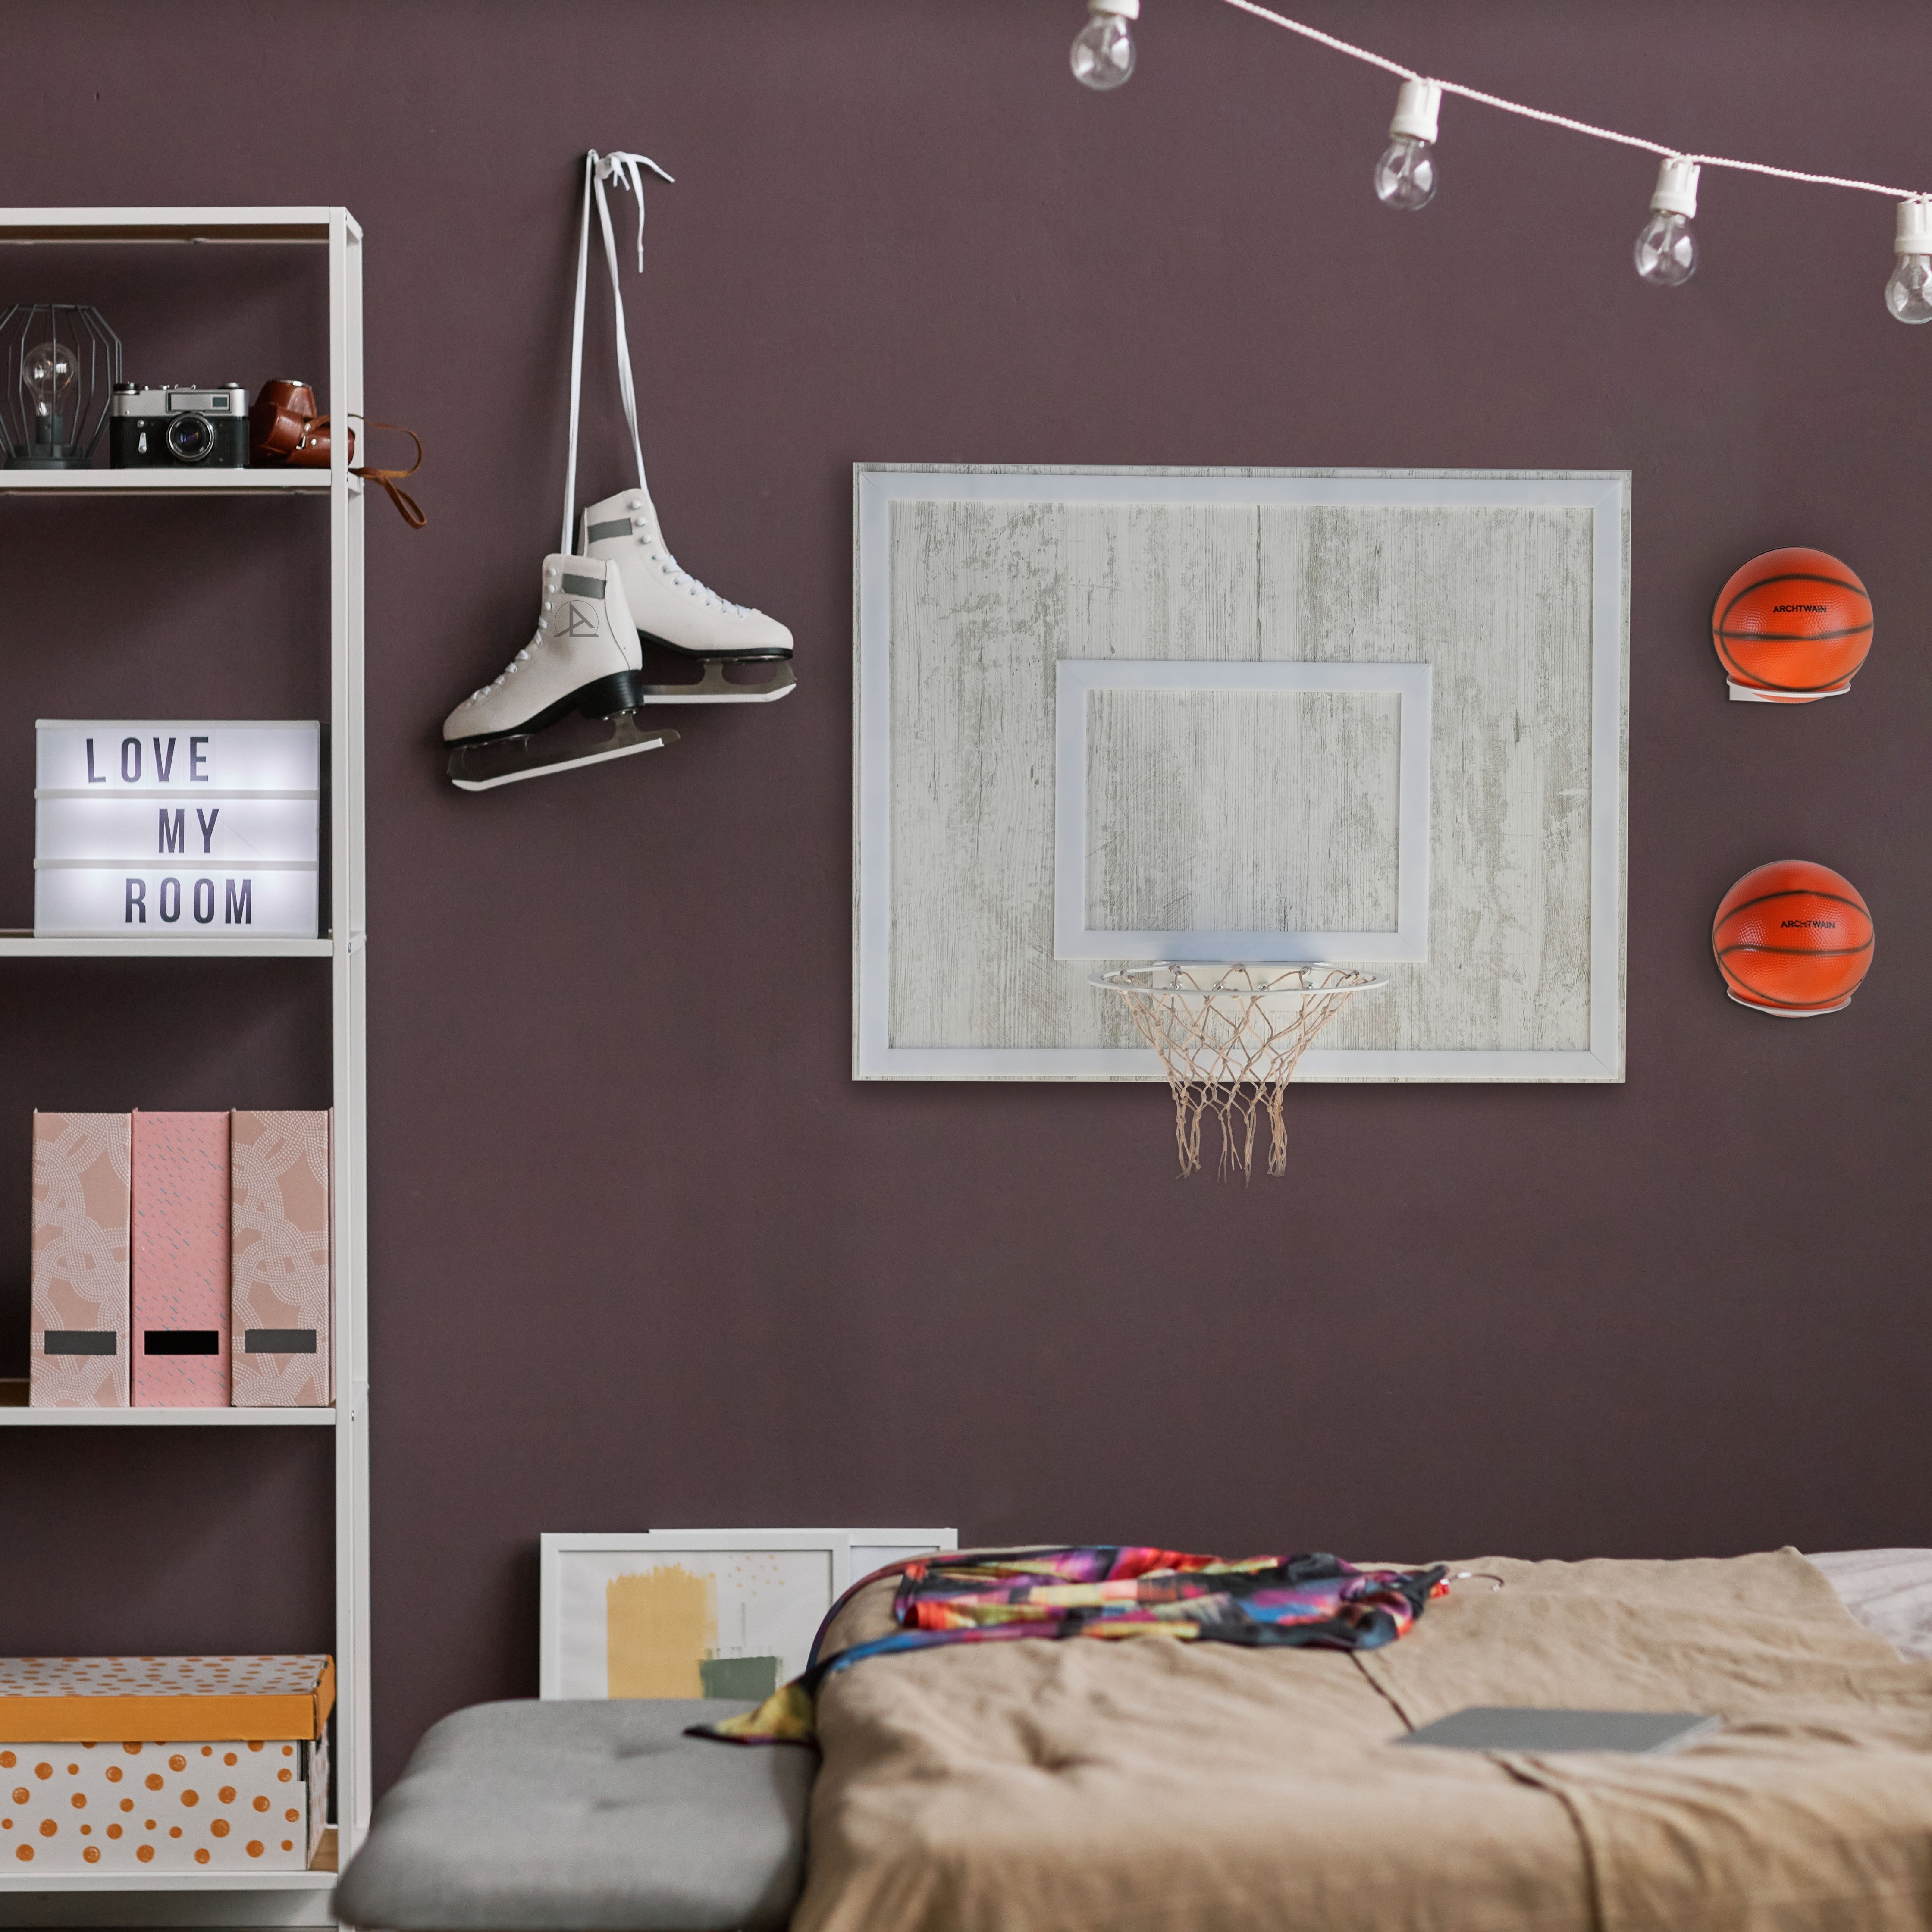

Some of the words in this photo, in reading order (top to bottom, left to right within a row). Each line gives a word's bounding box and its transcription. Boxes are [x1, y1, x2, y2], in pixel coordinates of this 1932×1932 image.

[86, 736, 209, 783] LOVE
[158, 808, 220, 853] MY
[125, 877, 252, 924] ROOM
[1781, 920, 1835, 929] ARCHTWAIN
